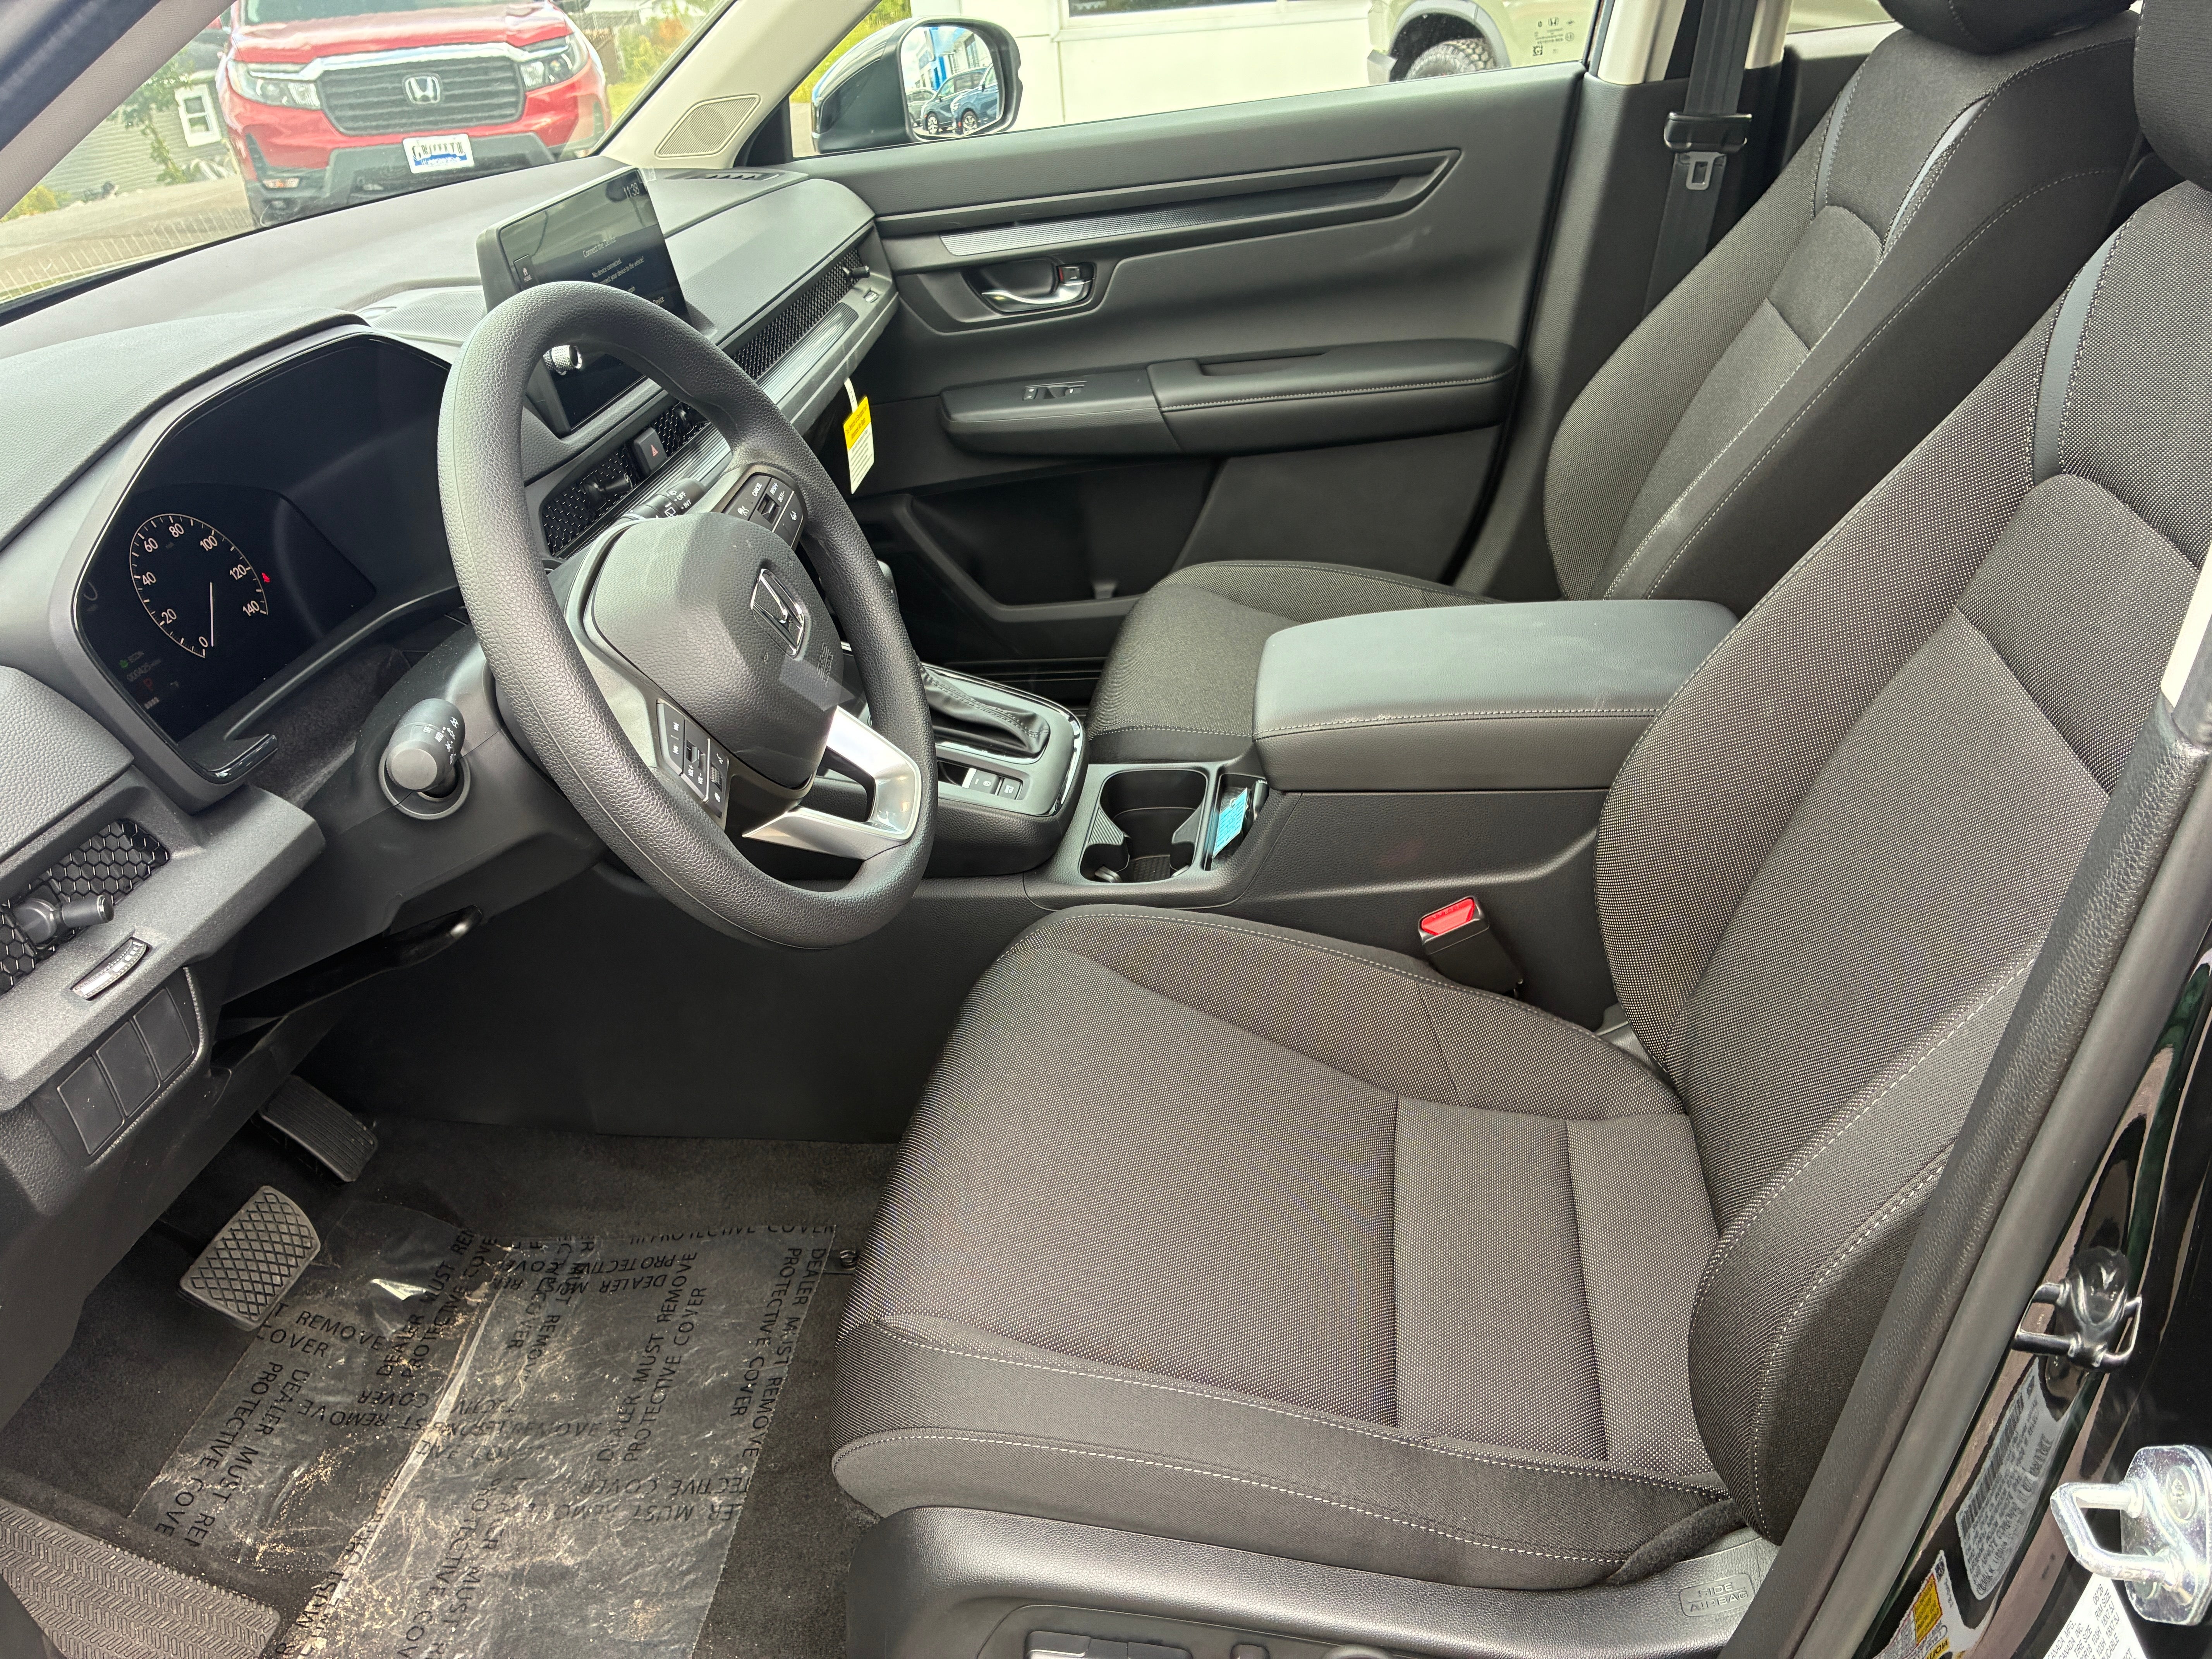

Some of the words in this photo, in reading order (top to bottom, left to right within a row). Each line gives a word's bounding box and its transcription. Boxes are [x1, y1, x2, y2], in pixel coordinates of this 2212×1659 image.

[623, 182, 640, 199] 11:38
[583, 246, 598, 258] Connect
[676, 491, 686, 501] OFF
[683, 499, 692, 508] INT
[169, 523, 184, 538] 80
[144, 538, 158, 553] 60
[200, 535, 218, 551] 100
[142, 572, 156, 586] 40
[230, 564, 247, 580] 120
[161, 608, 177, 624] 20
[243, 600, 260, 617] 140
[198, 636, 208, 648] 0
[599, 1274, 668, 1294] DEALER
[792, 1248, 826, 1305] DEALER
[756, 1248, 802, 1348] PROTECTIVE
[632, 1333, 664, 1382] MUST
[656, 1252, 697, 1323] REMOVE
[296, 1310, 385, 1351] REMOVE
[774, 1317, 800, 1365] MUST
[623, 1355, 682, 1462] PROTECTIVE
[673, 1287, 707, 1346] COVER
[730, 1356, 765, 1417] COVER
[254, 1369, 311, 1435] DEALER
[358, 1390, 429, 1408] COVER
[201, 1362, 283, 1469] PROTECTIVE
[297, 1399, 389, 1426] REMOVE
[742, 1376, 783, 1458] REMOVE
[213, 1446, 259, 1504] MUST
[581, 1478, 658, 1495] COVER
[628, 1504, 695, 1522] MUST
[442, 1566, 481, 1627] MUST
[1698, 1582, 1733, 1598] SIDE
[1690, 1590, 1748, 1612] AIRBAG
[2095, 1603, 2104, 1621] RIM
[2102, 1589, 2111, 1608] SIZE
[2074, 1639, 2084, 1657] TIRE
[2082, 1625, 2092, 1644] SIZE
